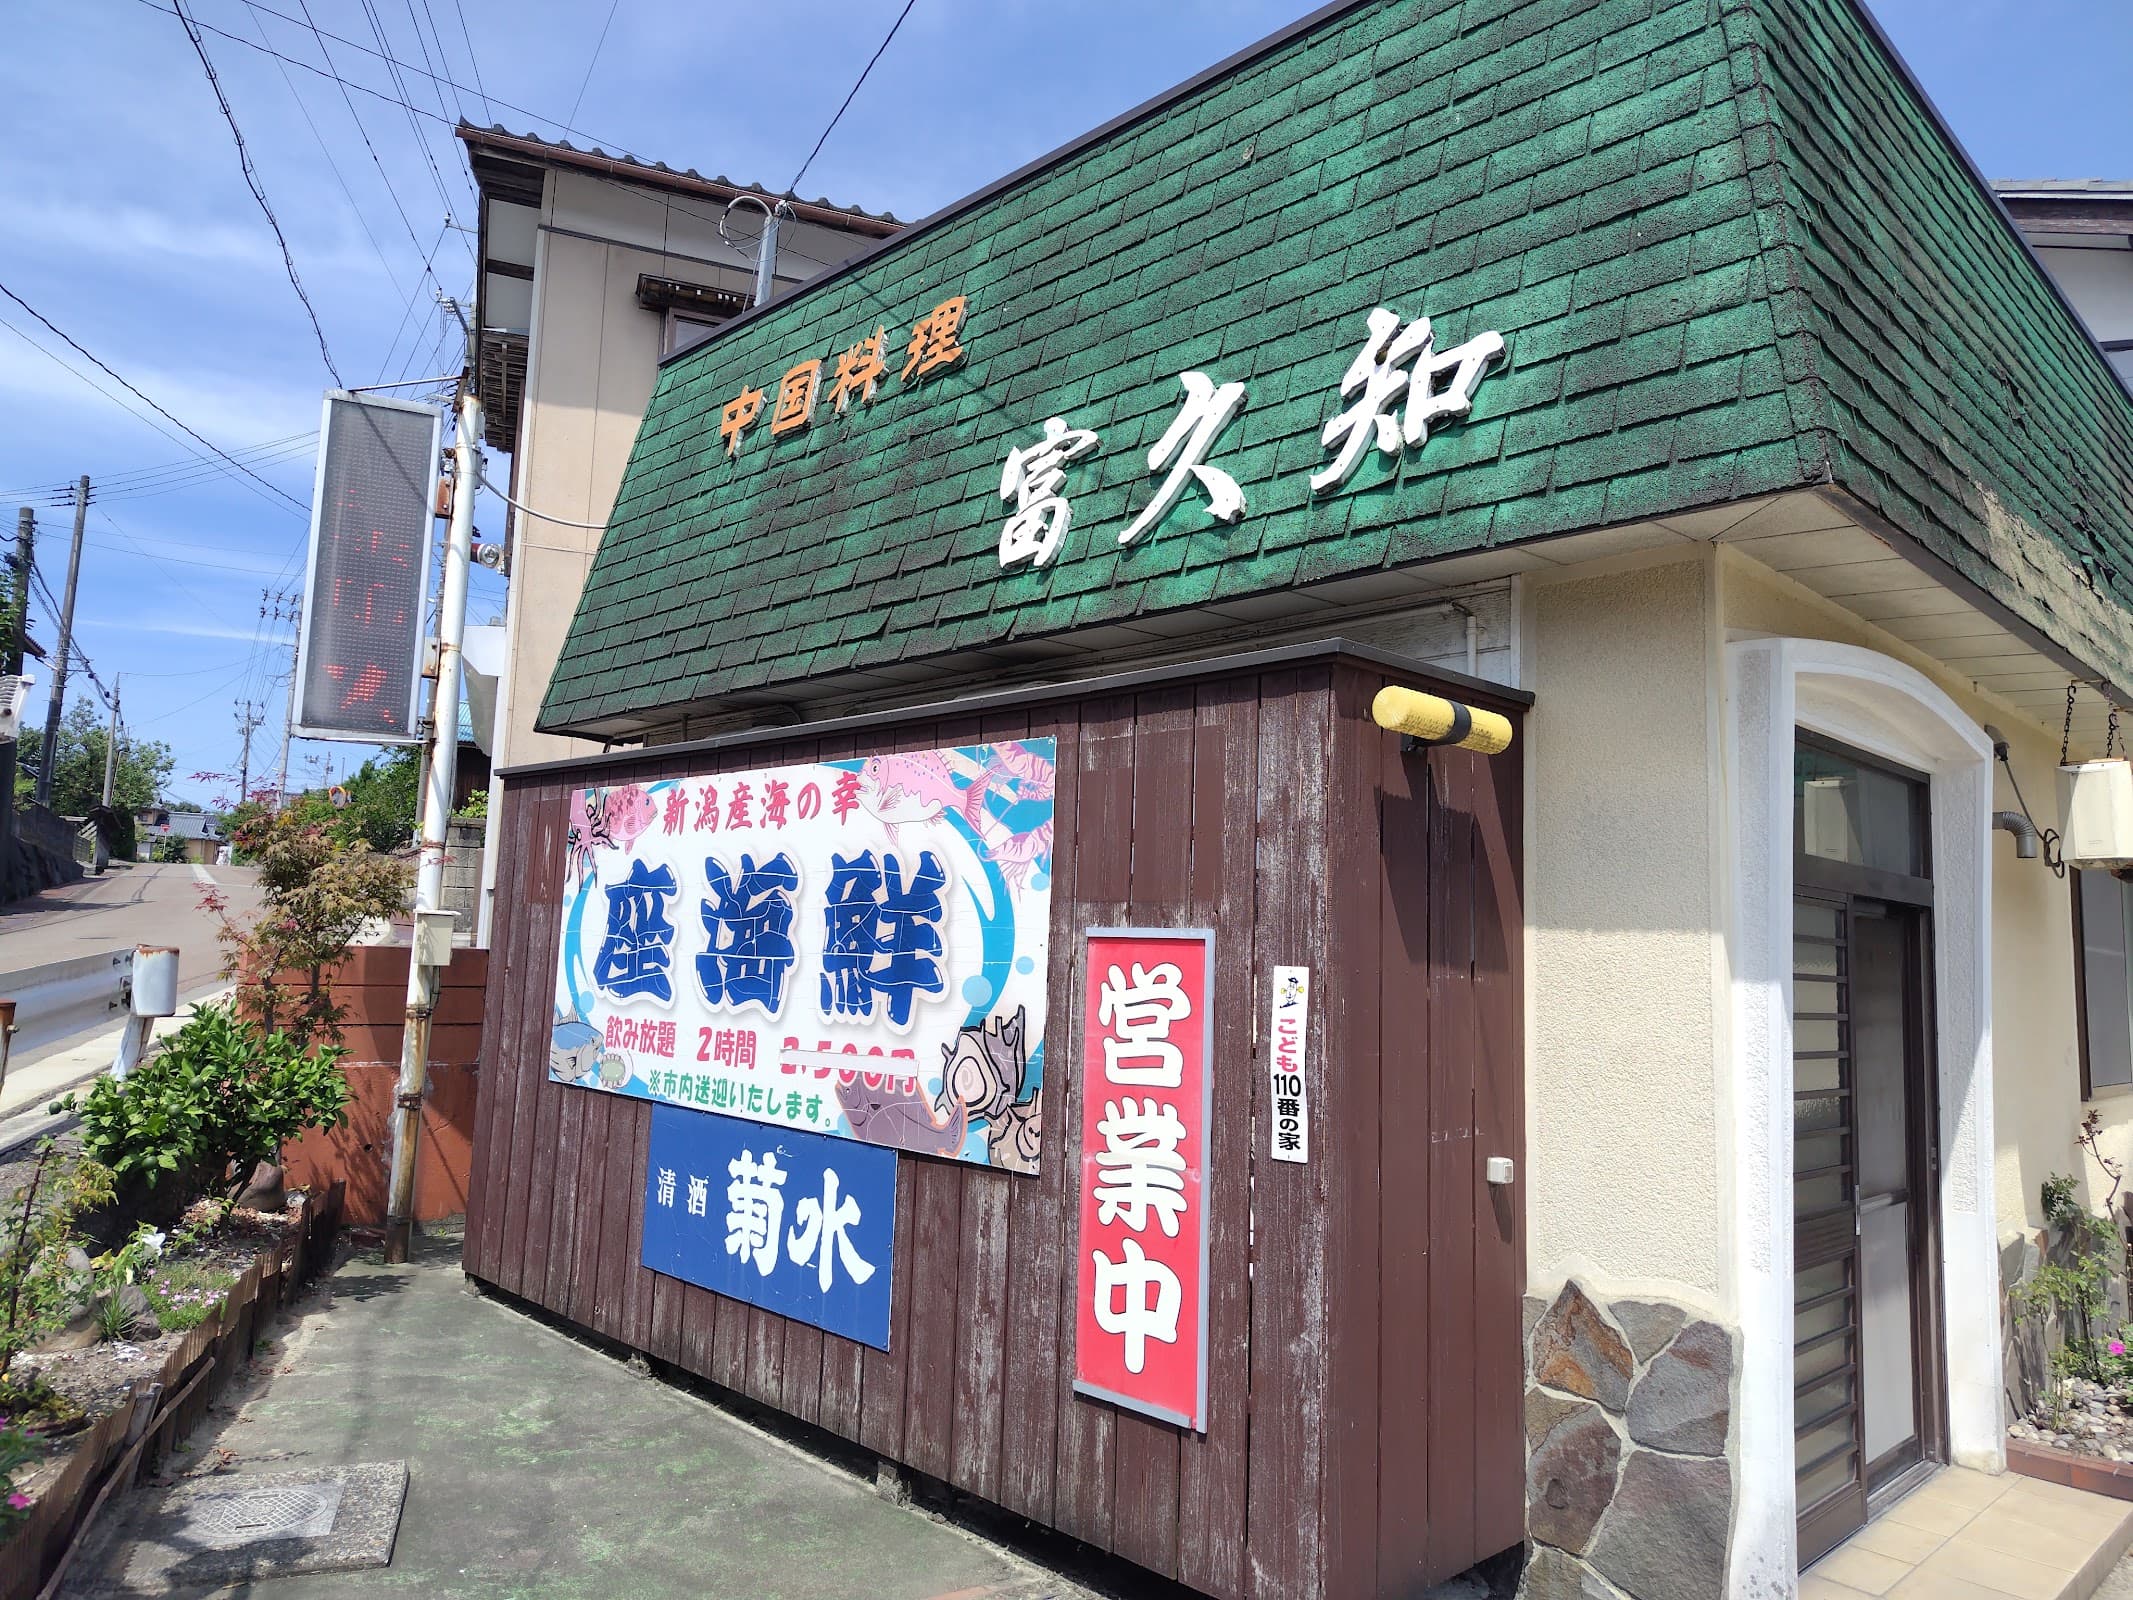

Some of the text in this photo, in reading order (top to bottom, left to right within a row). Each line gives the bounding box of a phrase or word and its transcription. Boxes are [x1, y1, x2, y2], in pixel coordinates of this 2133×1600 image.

[720, 295, 968, 457] 中国料理
[999, 307, 1505, 570] 富久知
[663, 771, 862, 837] 新潟産海の幸
[604, 1015, 677, 1058] 飲み放題
[696, 1026, 757, 1070] 2時間
[657, 1149, 876, 1293] 清酒 菊水
[1092, 961, 1193, 1374] 営業中
